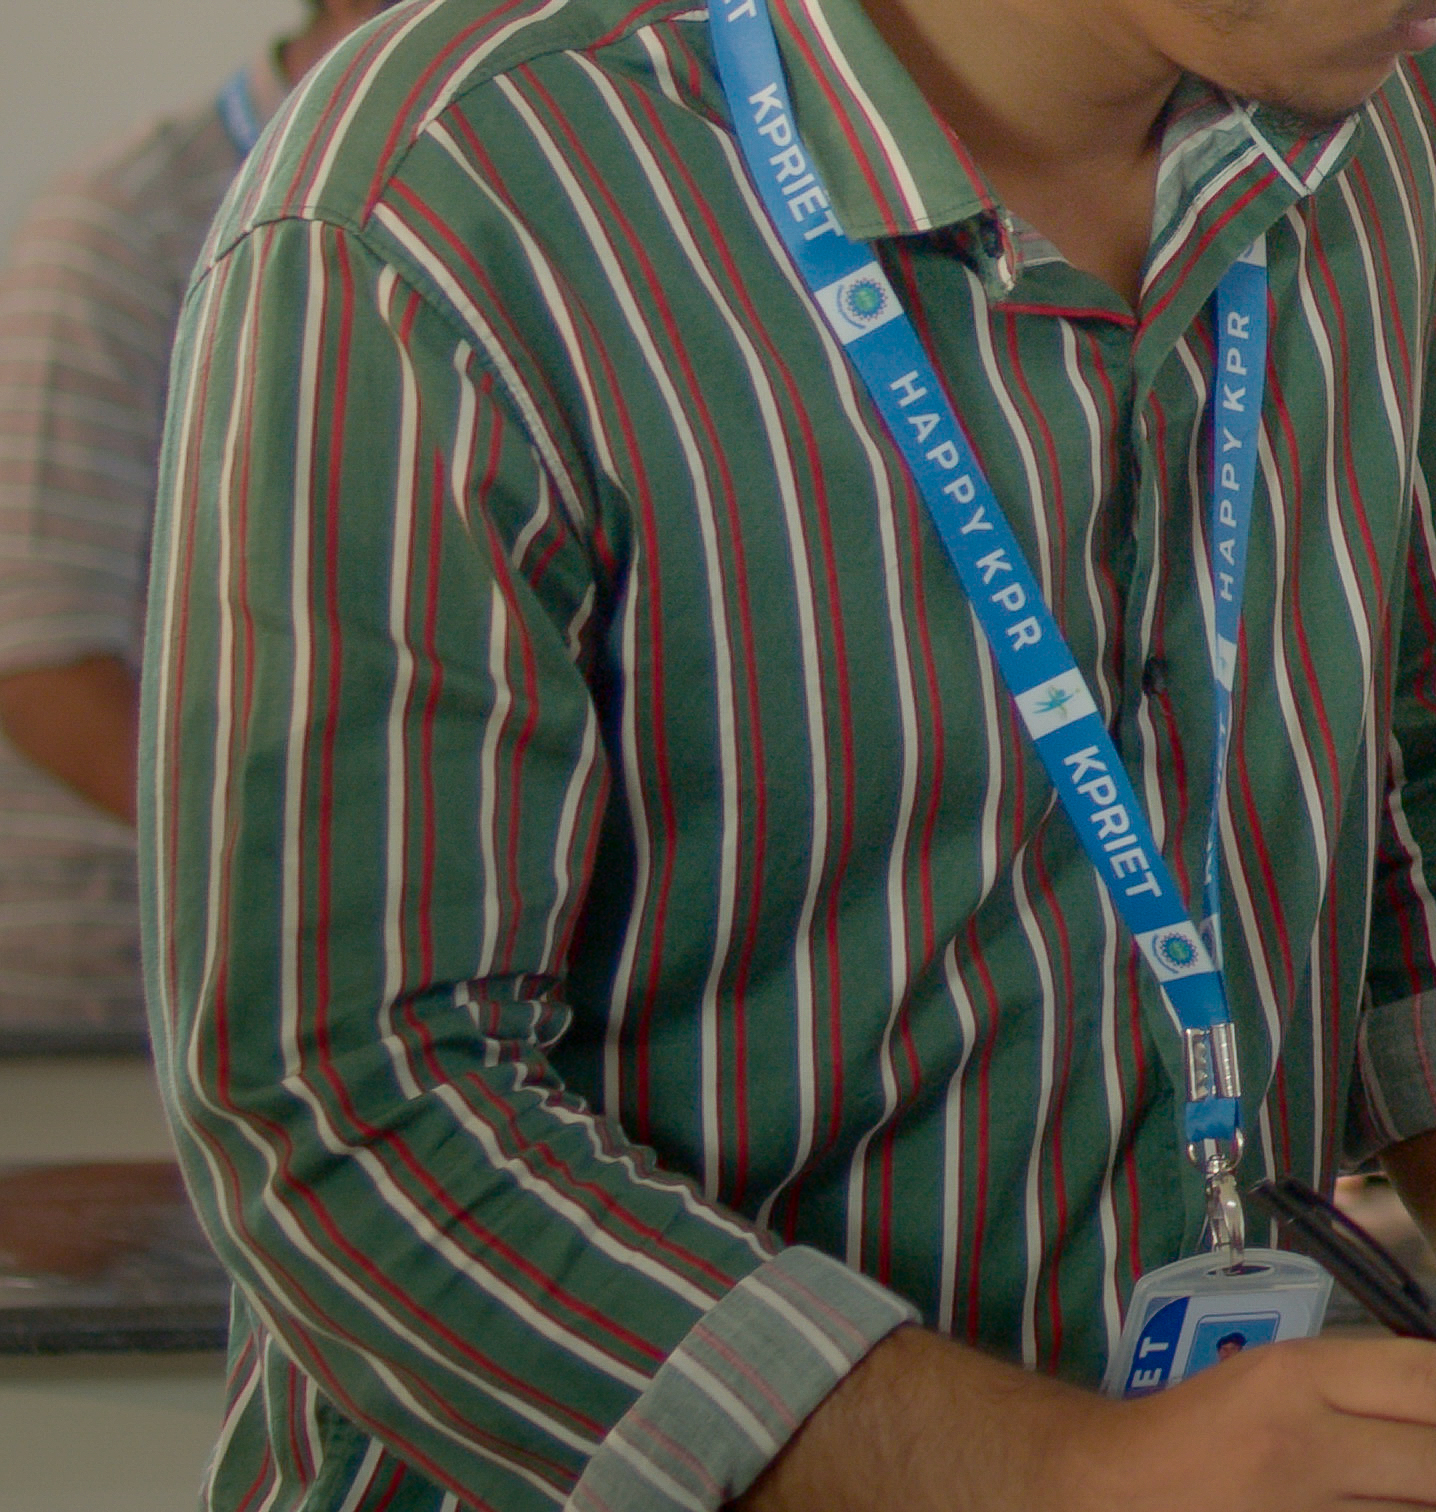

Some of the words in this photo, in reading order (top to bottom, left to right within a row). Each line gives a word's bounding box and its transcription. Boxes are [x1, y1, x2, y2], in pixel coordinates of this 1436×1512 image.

[748, 82, 845, 244] KPRIET
[1222, 311, 1251, 412] KPR
[889, 370, 993, 536] HAPPY
[975, 548, 1043, 652] KPR
[1219, 427, 1244, 602] HAPPY
[1063, 745, 1163, 900] KPRIET
